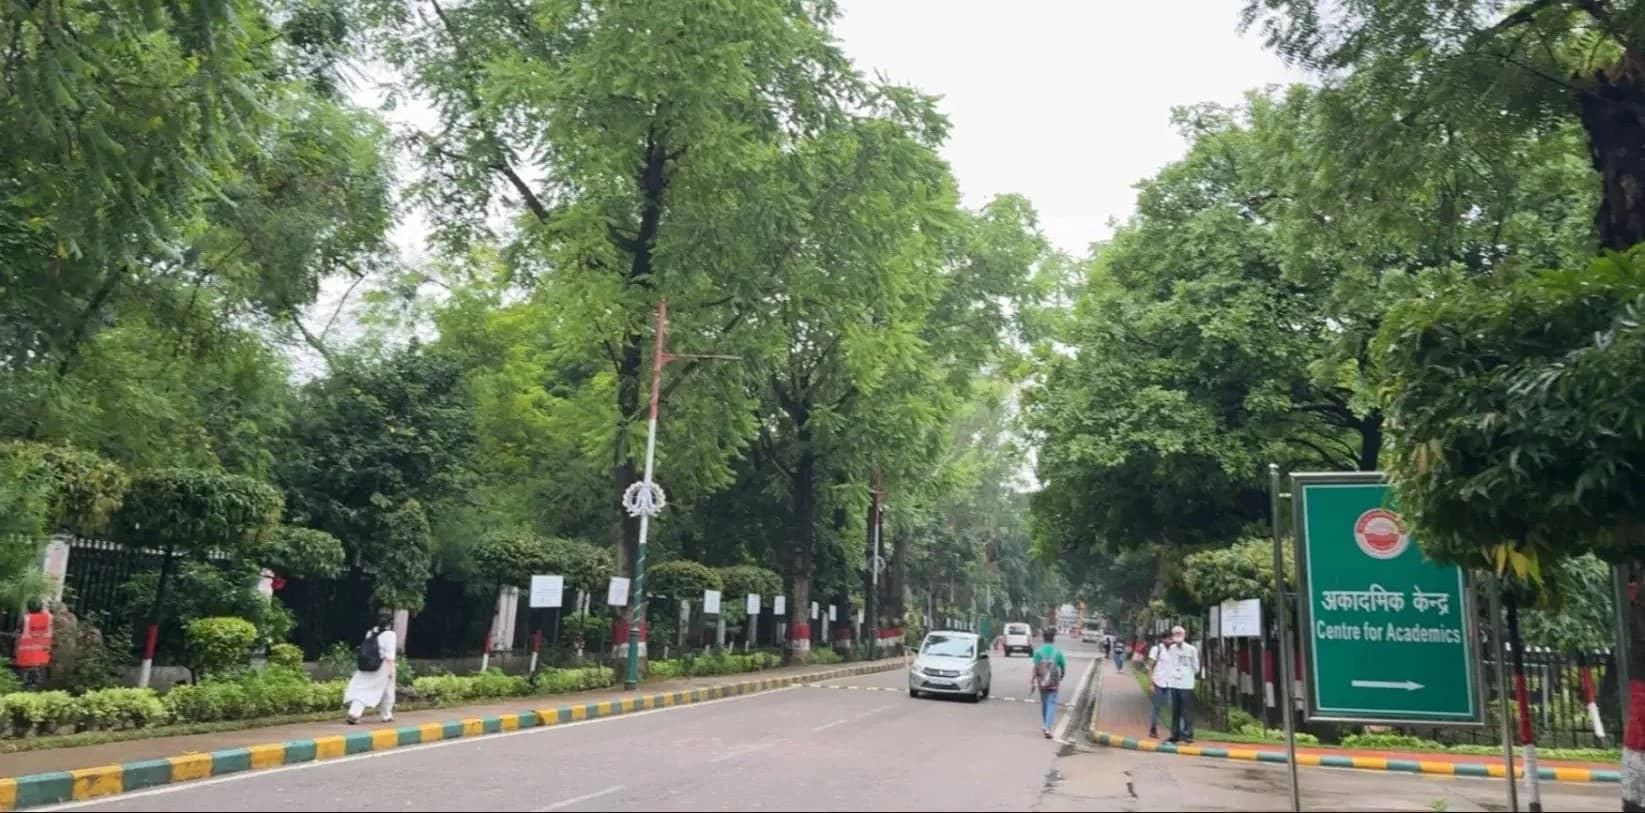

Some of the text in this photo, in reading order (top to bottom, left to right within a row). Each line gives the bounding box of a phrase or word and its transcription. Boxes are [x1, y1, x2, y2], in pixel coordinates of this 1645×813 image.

[1321, 584, 1450, 615] अकादमिक केन्द्र
[1317, 620, 1461, 643] Centre for Academics
